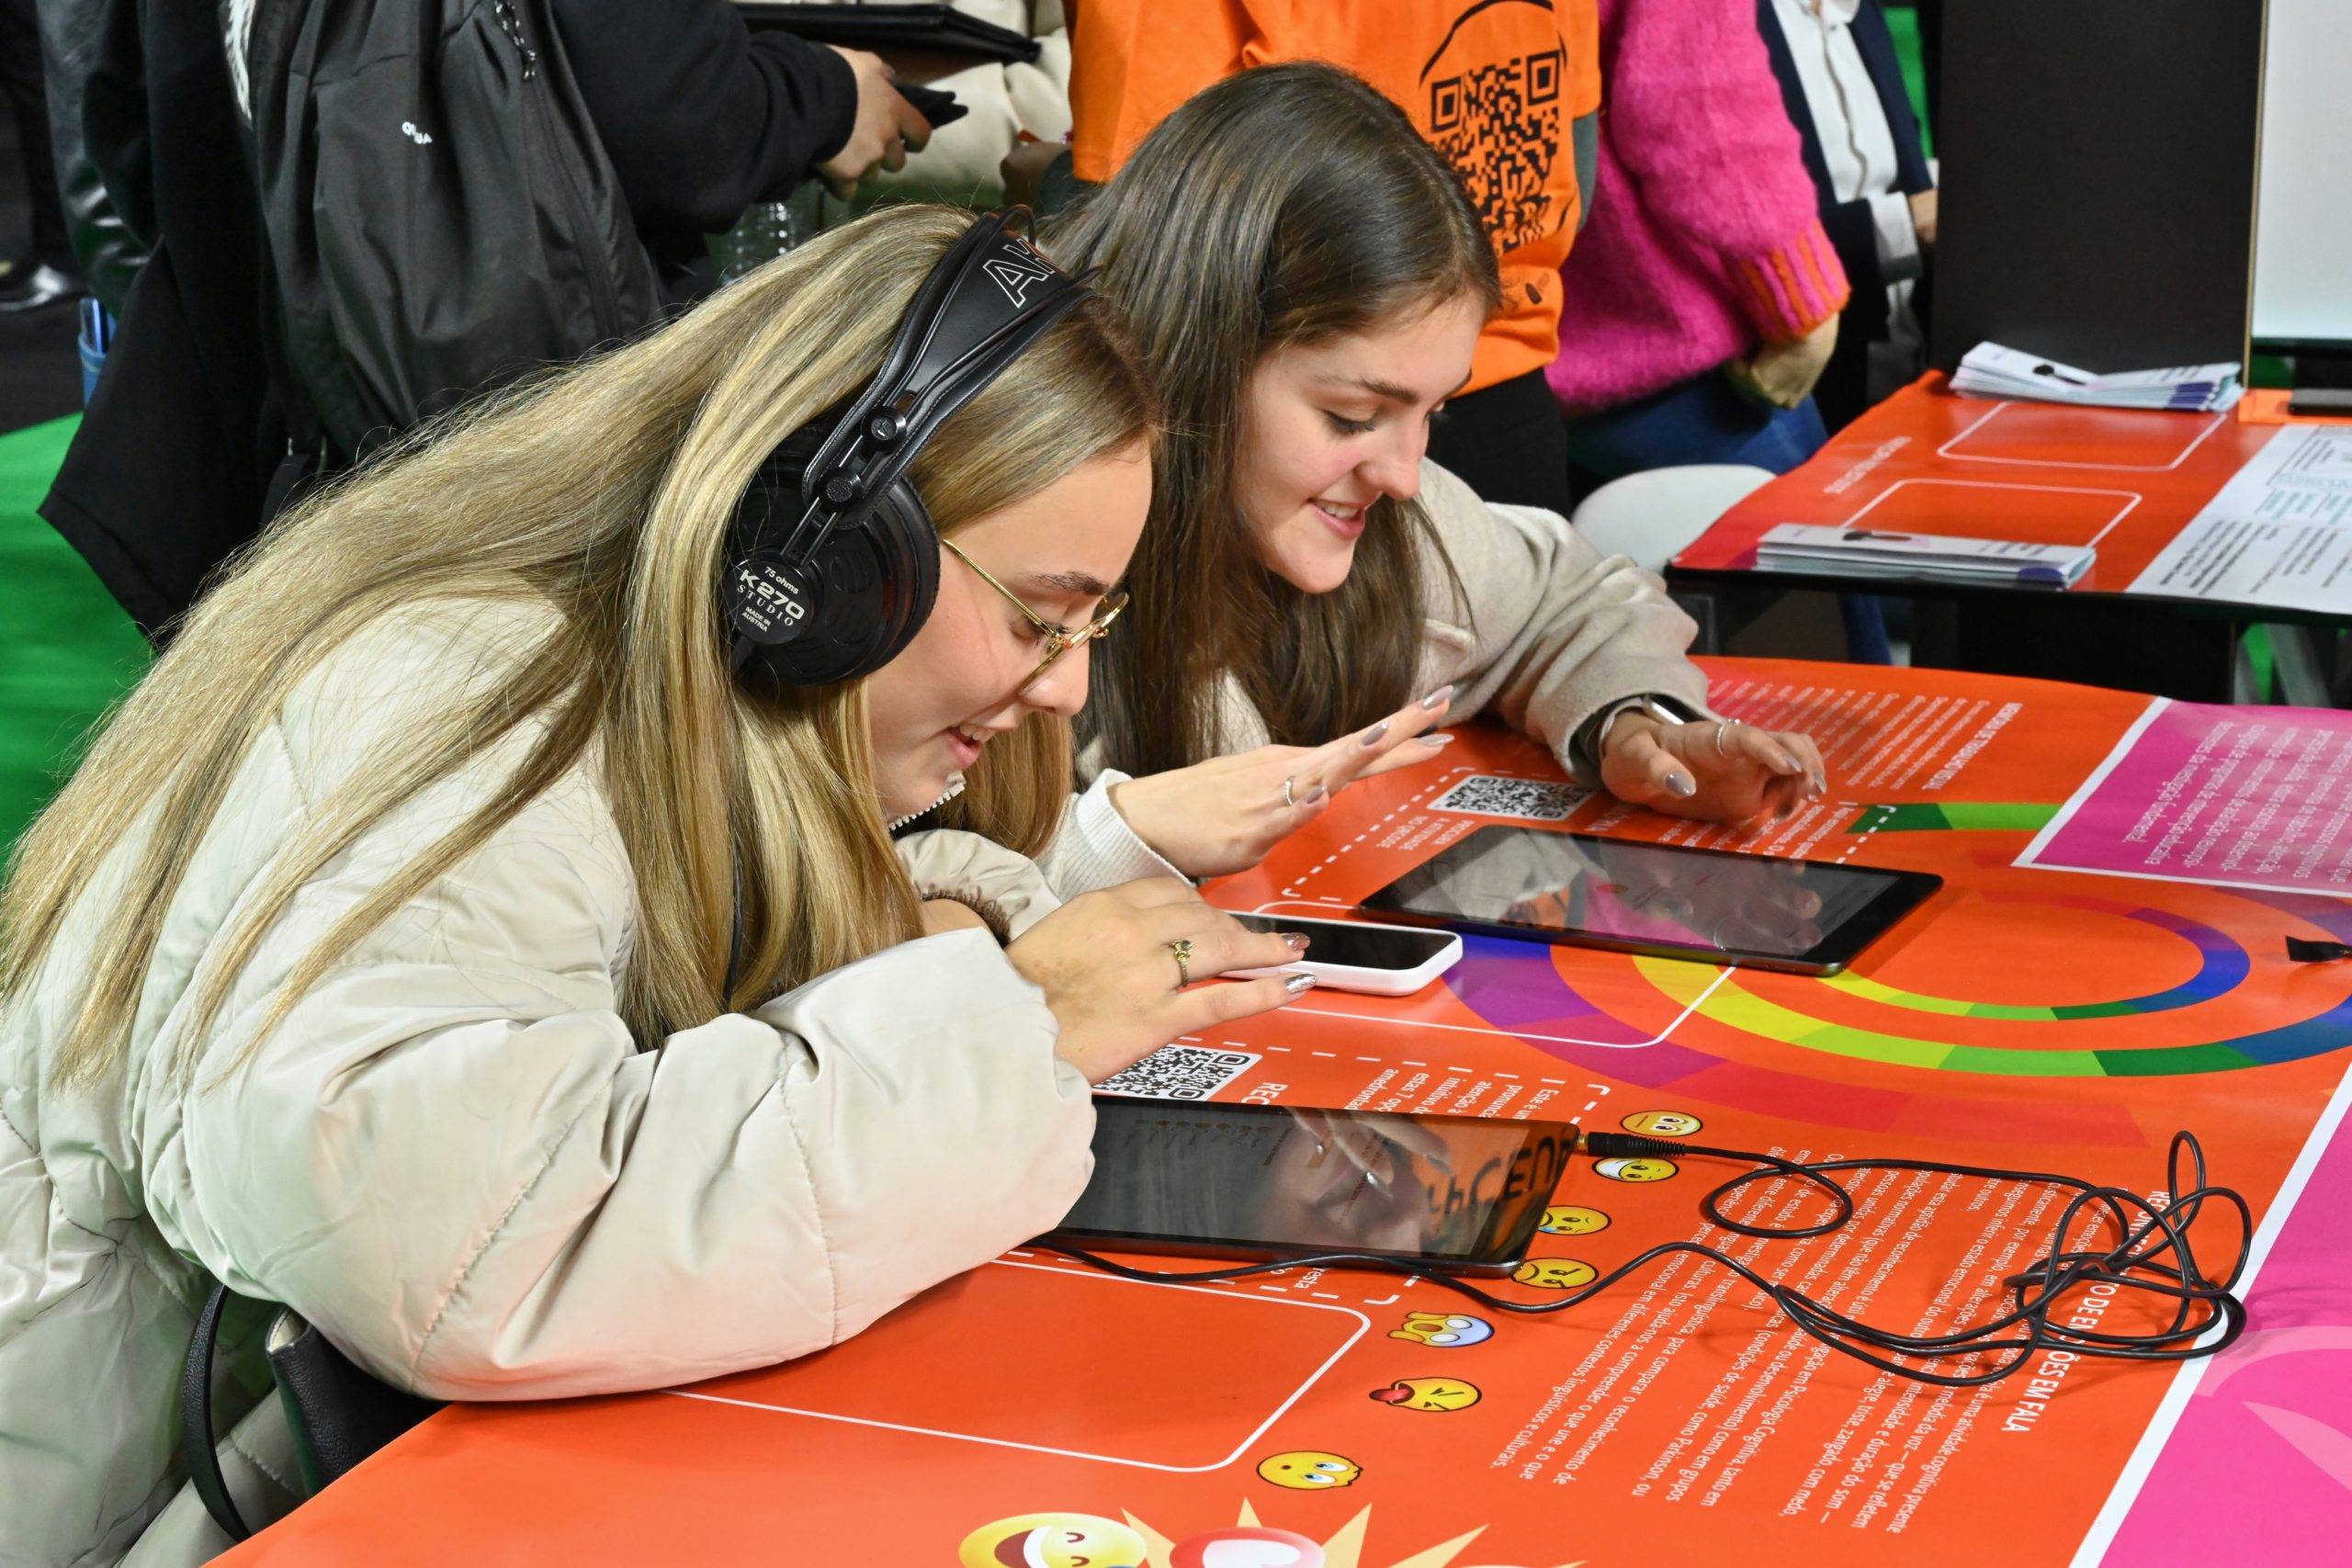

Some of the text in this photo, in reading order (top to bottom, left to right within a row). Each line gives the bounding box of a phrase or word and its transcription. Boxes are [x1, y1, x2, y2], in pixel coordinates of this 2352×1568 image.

[764, 566, 799, 594] 75 ohms
[737, 584, 794, 626] STUDIO
[745, 606, 772, 626] MADE IN
[742, 612, 768, 633] AUSTRIA
[1401, 1073, 1430, 1091] estas
[1421, 1077, 1466, 1105] intuitivo
[1454, 1079, 1492, 1108] atenção
[1530, 1089, 1558, 1103] Este
[1765, 1179, 1786, 1195] entre
[1795, 1190, 1814, 1198] de
[1871, 1170, 1900, 1196] pessoas
[1853, 1198, 1878, 1219] unidas
[1928, 1193, 1947, 1205] esta
[1775, 1200, 1801, 1221] estudo
[1872, 1201, 1908, 1236] normativas
[1909, 1207, 1937, 1231] aptidão
[1902, 1232, 1922, 1240] de
[1981, 1218, 2008, 1238] inferir
[2013, 1228, 2029, 1240] por
[1860, 1237, 1884, 1252] (que
[1781, 1247, 1805, 1267] como
[1804, 1234, 1854, 1279] determinadas
[1849, 1253, 1869, 1266] não
[1960, 1245, 1984, 1268] estado
[1988, 1242, 2019, 1271] exemplo,
[1649, 1254, 1689, 1291] emocional
[1682, 1261, 1716, 1290] culturas.
[1771, 1269, 1789, 1280] ser
[1838, 1267, 1860, 1280] têm
[1861, 1241, 1910, 1295] reconhecimento
[1933, 1269, 1968, 1306] emocional
[1981, 1275, 1997, 1286] em
[1638, 1291, 1656, 1302] em
[1668, 1292, 1693, 1306] Isto
[1676, 1280, 1736, 1334] translinguística,
[1954, 1288, 1992, 1325] alterações
[2077, 1298, 2109, 1315] DE
[1847, 1302, 1868, 1314] útil
[1926, 1306, 1944, 1316] do
[1605, 1303, 1649, 1338] diferentes
[1636, 1308, 1677, 1343] ajuda-nos
[1662, 1337, 1685, 1354] para
[1732, 1330, 1777, 1371] (condições
[1775, 1350, 1792, 1360] ou
[1573, 1340, 1612, 1376] contextos
[1587, 1352, 1637, 1404] compreender
[1630, 1358, 1668, 1394] comparar
[1723, 1372, 1744, 1382] de
[1793, 1371, 1812, 1384] em
[1698, 1384, 1730, 1409] saúde,
[1716, 1362, 1788, 1430] desenvolvimento)
[1860, 1378, 1894, 1403] alegre,
[2025, 1379, 2059, 1398] EM
[1532, 1378, 1587, 1423] linguísticos
[1761, 1385, 1806, 1425] Psicologia
[1882, 1382, 1928, 1428] intensidade
[1922, 1391, 1953, 1422] melodia
[1962, 1399, 1984, 1416] uma
[1564, 1413, 1586, 1427] que
[1680, 1413, 1707, 1435] como
[1842, 1405, 1874, 1427] triste,
[2002, 1402, 2045, 1431] FALA
[1549, 1429, 1571, 1445] une
[1566, 1405, 1629, 1470] reconhecimento
[1915, 1424, 1937, 1434] da
[1939, 1418, 1973, 1455] atividade
[1490, 1431, 1532, 1468] culturais.
[1702, 1431, 1729, 1454] como
[1727, 1427, 1775, 1465] Cognitiva,
[1815, 1429, 1854, 1466] zangado,
[1904, 1436, 1924, 1450] voz
[1641, 1438, 1692, 1480] Parkinson,
[1690, 1455, 1711, 1469] em
[1851, 1438, 1889, 1472] duração
[1520, 1462, 1542, 1479] que
[1553, 1472, 1576, 1484] de
[1713, 1468, 1742, 1491] tanto
[1803, 1469, 1825, 1488] com
[1841, 1474, 1864, 1486] do
[1884, 1463, 1905, 1479] que
[1913, 1456, 1948, 1494] cognitiva
[1632, 1484, 1650, 1495] ou
[1667, 1469, 1699, 1501] grupos
[1876, 1480, 1894, 1490] se
[1701, 1492, 1720, 1506] em
[1779, 1490, 1811, 1516] medo,
[1826, 1489, 1849, 1508] som
[1852, 1492, 1887, 1529] refletem
[1886, 1495, 1922, 1532] presente
